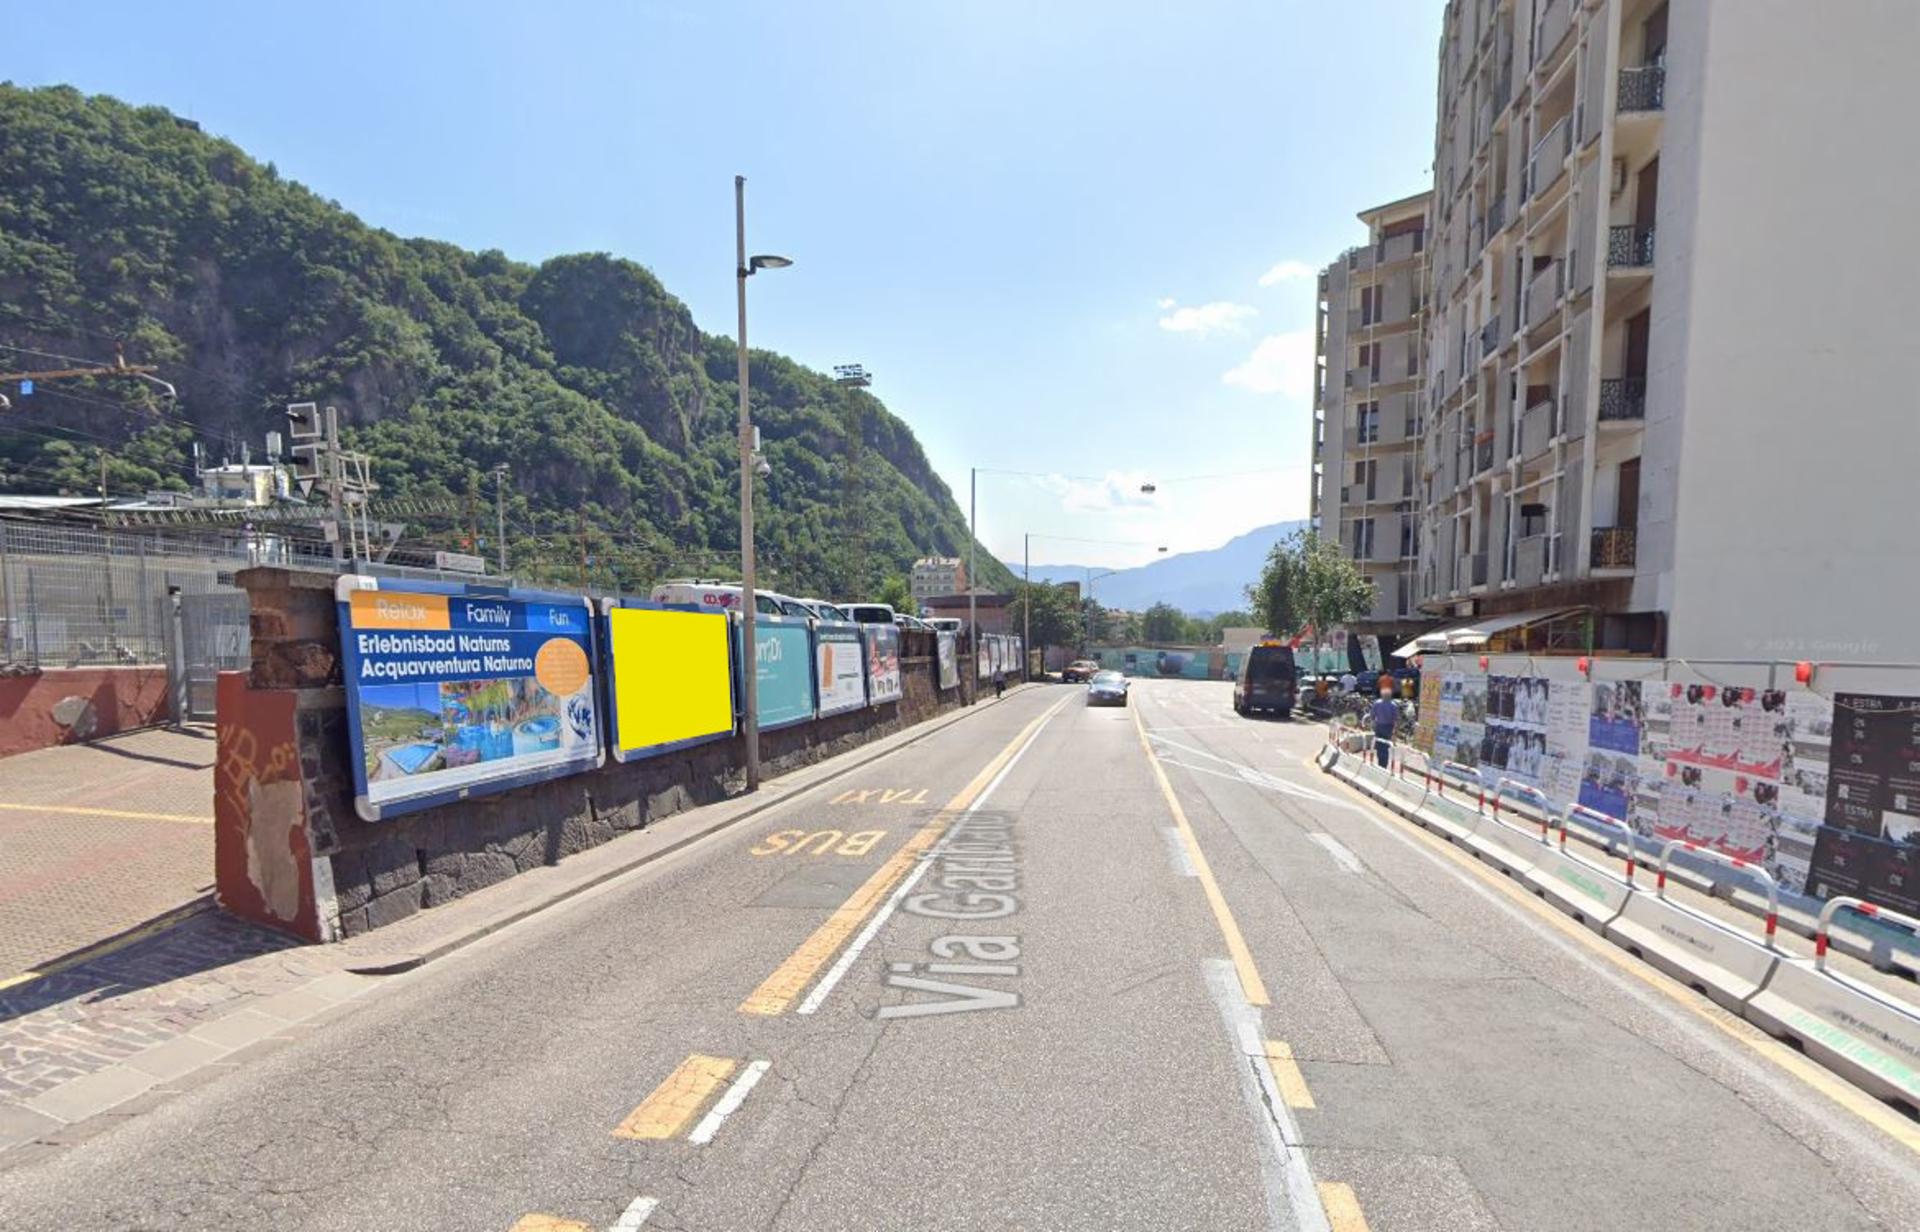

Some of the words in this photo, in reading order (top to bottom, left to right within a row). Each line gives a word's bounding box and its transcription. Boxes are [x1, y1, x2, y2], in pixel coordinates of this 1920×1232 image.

[377, 600, 427, 621] Relax
[466, 603, 512, 627] Family
[549, 608, 569, 626] Fun
[358, 634, 456, 654] Erlebnisbad
[459, 636, 511, 653] Naturns
[361, 656, 481, 680] Acquavventura
[483, 656, 533, 673] Naturno
[751, 830, 888, 856] BUS
